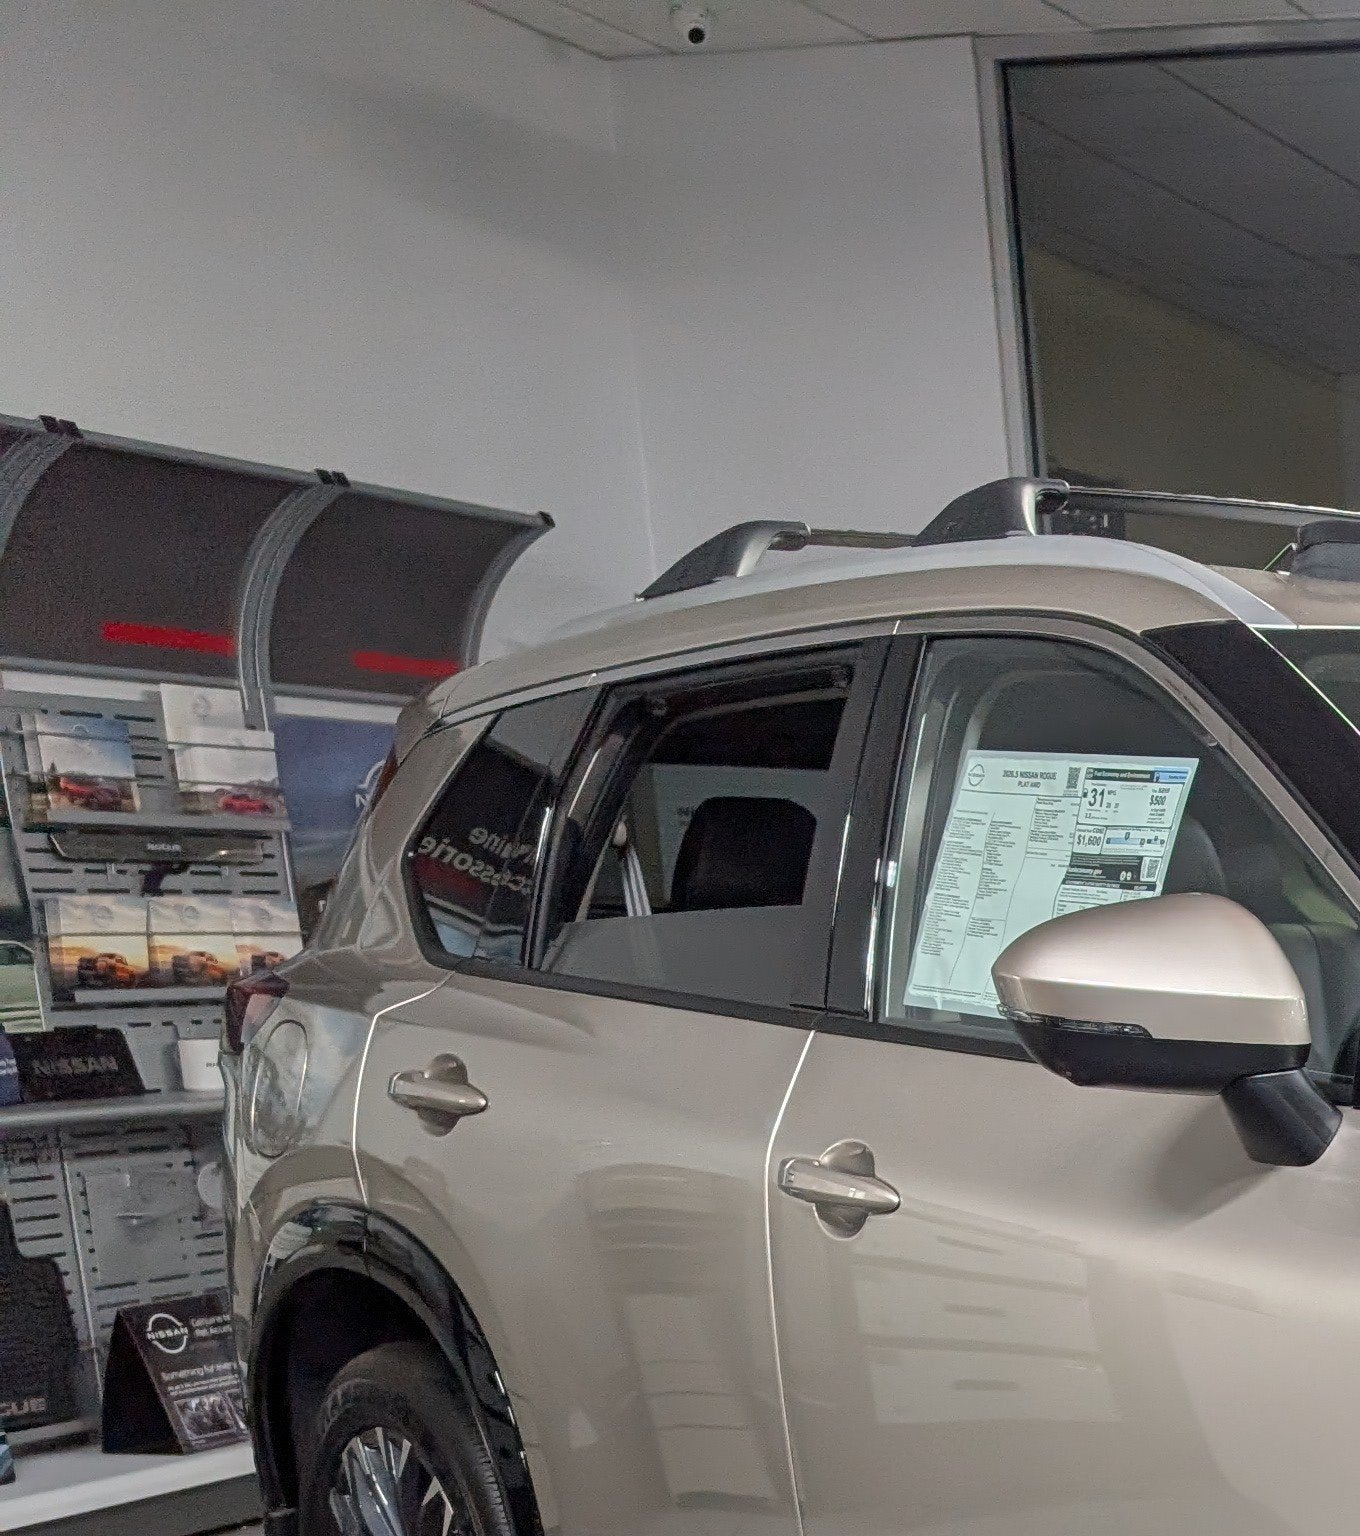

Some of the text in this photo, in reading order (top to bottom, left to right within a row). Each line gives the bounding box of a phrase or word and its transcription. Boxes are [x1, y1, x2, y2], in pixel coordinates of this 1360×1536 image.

[1019, 770, 1039, 779] NISSAN
[1039, 771, 1057, 780] ROGUE
[1088, 788, 1105, 808] 31
[1149, 794, 1167, 806] $500
[1077, 833, 1101, 848] $1,600
[31, 1055, 119, 1076] NISSAN
[146, 1326, 189, 1341] NISSAN
